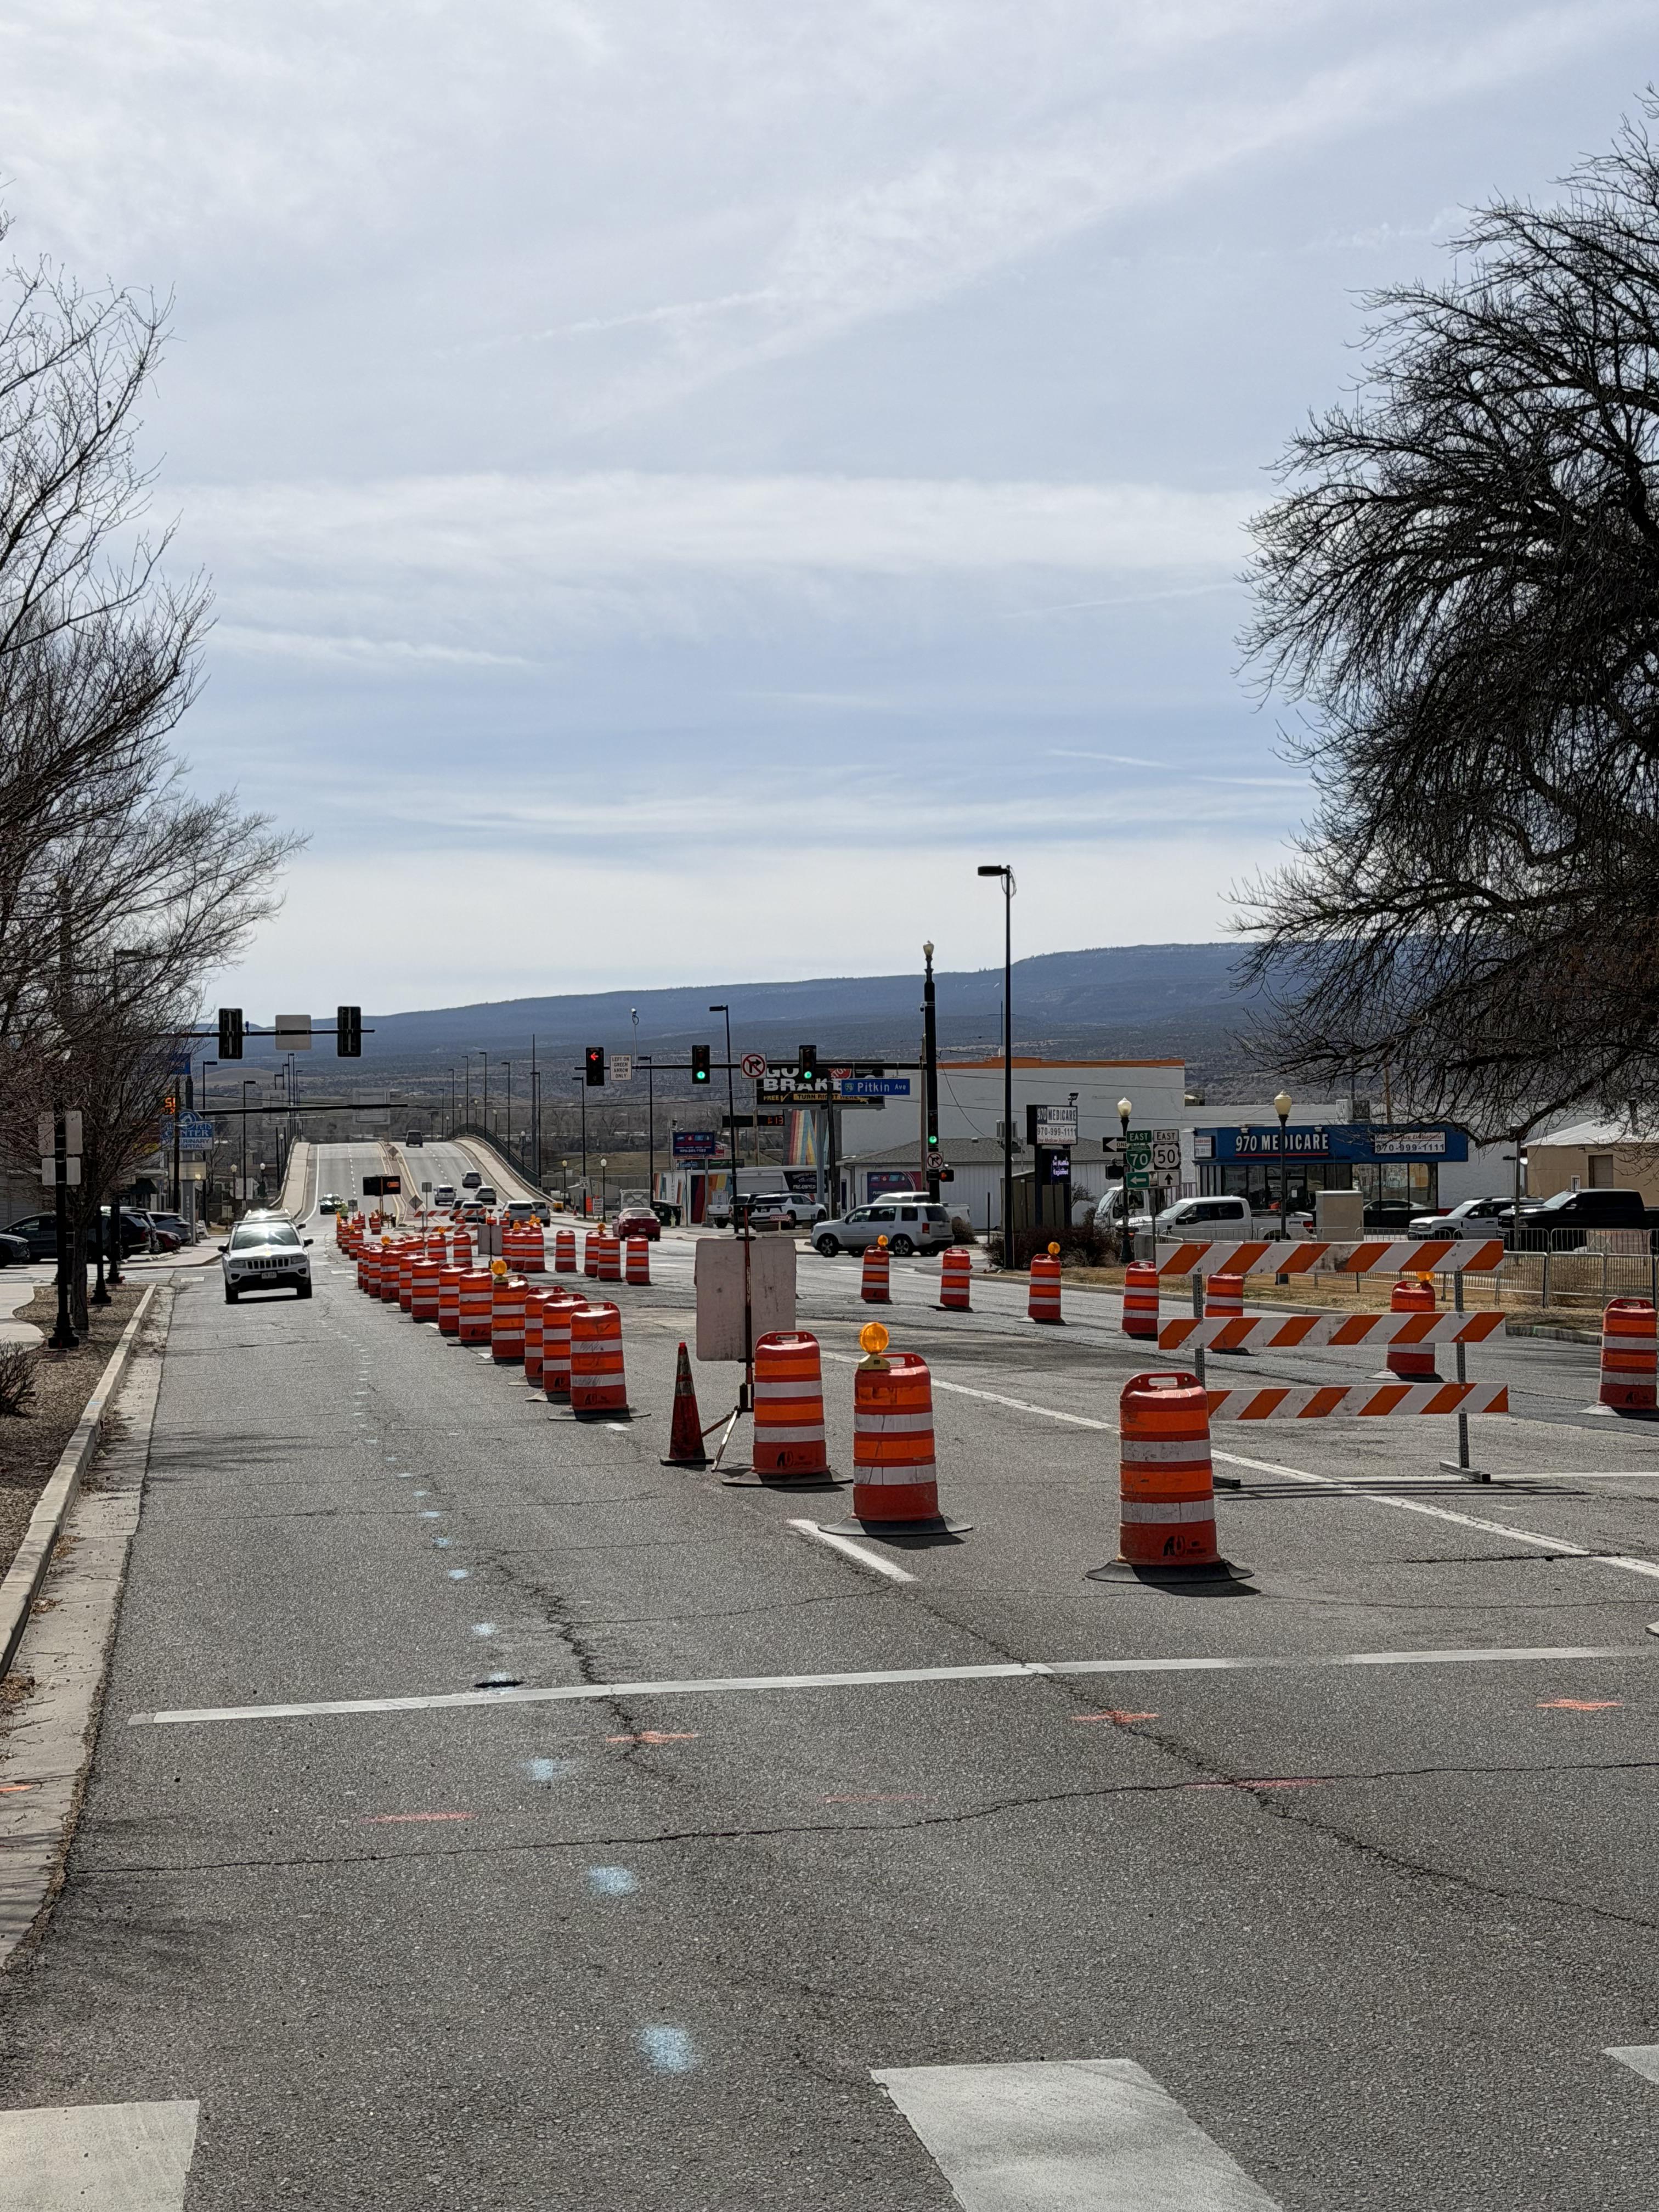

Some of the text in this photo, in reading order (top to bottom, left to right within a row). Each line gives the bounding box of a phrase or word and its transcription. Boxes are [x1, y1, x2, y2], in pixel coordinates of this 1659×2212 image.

[857, 1082, 890, 1093] Pitkin
[1037, 1108, 1076, 1121] 970 MEDICARE
[1037, 1127, 1076, 1136] 970-999-1111
[1130, 1132, 1148, 1141] EAST
[1156, 1132, 1176, 1141] EAST
[1235, 1136, 1257, 1152] 970
[1376, 1143, 1444, 1152] 970-999-1111
[1130, 1153, 1148, 1166] 70
[1158, 1149, 1176, 1164] 50
